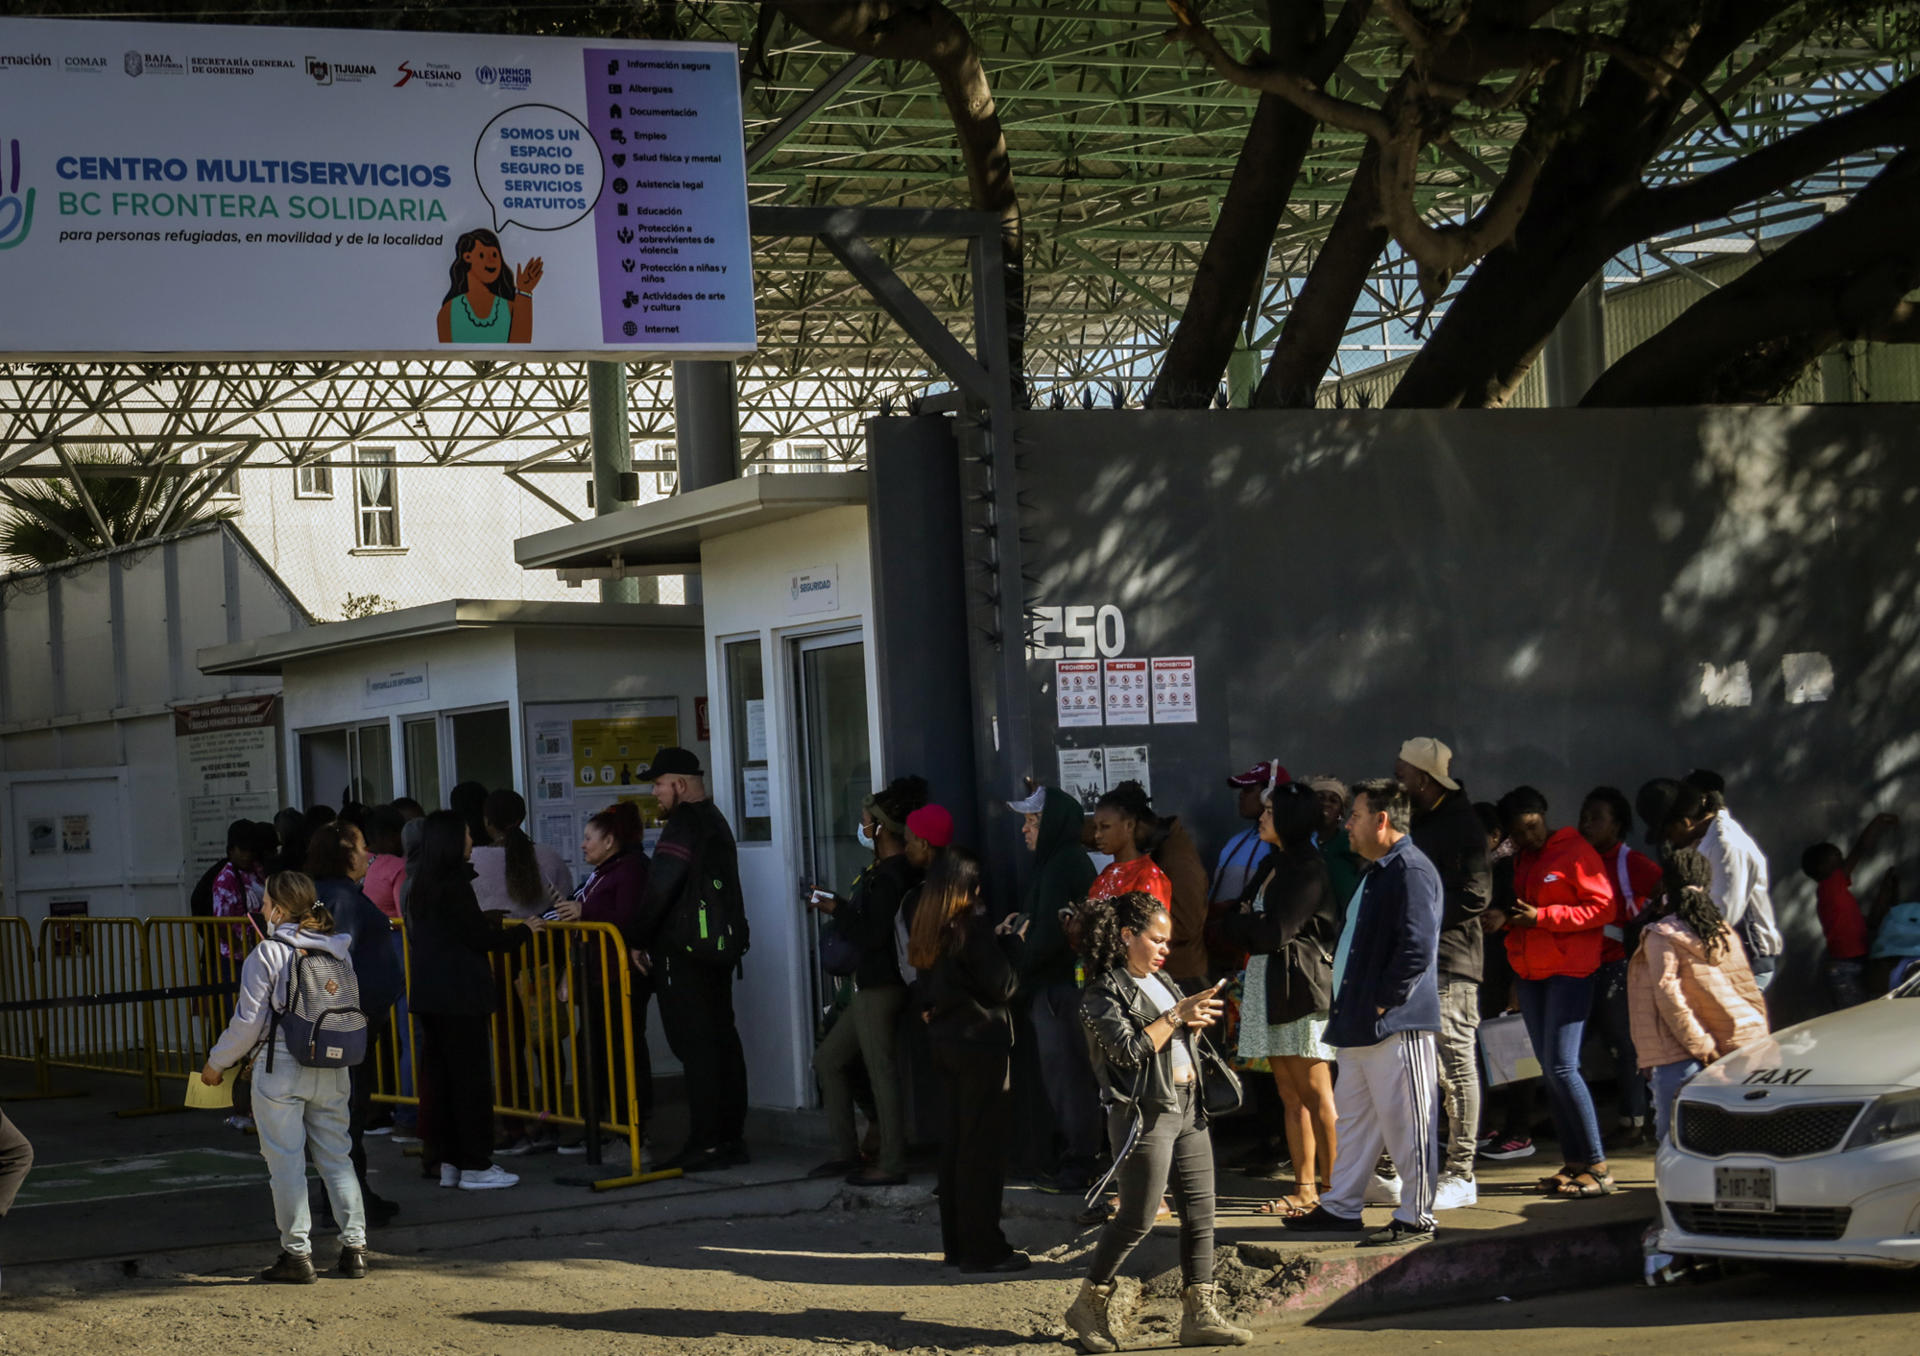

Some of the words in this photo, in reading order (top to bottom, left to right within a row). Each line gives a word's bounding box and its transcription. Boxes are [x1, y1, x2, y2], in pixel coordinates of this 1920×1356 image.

[65, 56, 108, 66] COMAR
[144, 54, 172, 63] BAJA
[191, 57, 250, 67] SECRETARÍA
[252, 59, 296, 68] GENERAL
[206, 66, 254, 75] GOBIERNO
[334, 63, 377, 74] TIJUANA
[627, 60, 680, 70] Información
[682, 62, 711, 71] segura
[498, 67, 532, 76] UNHCR
[499, 75, 532, 84] ACNUR
[629, 84, 673, 95] Albergues
[630, 107, 698, 117] Documentación
[500, 128, 555, 140] SOMOS
[558, 129, 580, 141] UN
[634, 131, 667, 141] Empleo
[510, 145, 572, 158] ESPACIO
[633, 153, 657, 161] Salud
[660, 153, 682, 162] física
[684, 155, 690, 163] y
[691, 155, 721, 163] mental
[56, 156, 188, 181] CENTRO
[196, 159, 451, 188] MULTISERVICIOS
[500, 162, 561, 175] SEGURO
[565, 164, 585, 175] DE
[504, 180, 583, 193] SERVICIOS
[636, 180, 680, 189] Asistencia
[682, 181, 704, 190] legal
[59, 192, 102, 216] BC
[112, 192, 279, 218] FRONTERA
[288, 195, 448, 222] SOLIDARIA
[503, 197, 587, 209] GRATUITOS
[637, 206, 682, 215] Educación
[638, 224, 684, 233] Protección
[59, 231, 92, 243] para
[96, 230, 161, 243] personas
[164, 229, 241, 245] refugiadas,
[246, 233, 262, 242] en
[267, 231, 332, 245] movilidad
[335, 235, 344, 247] y
[346, 232, 364, 245] de
[367, 232, 379, 245] la
[383, 233, 443, 246] localidad
[639, 236, 702, 244] sobrevivientes
[640, 246, 679, 254] violencia
[640, 263, 687, 272] Protección
[696, 263, 719, 272] niñas
[721, 265, 727, 273] y
[641, 274, 665, 283] niños
[642, 292, 693, 300] Actividades
[695, 292, 706, 300] de
[708, 292, 726, 300] arte
[643, 304, 648, 312] y
[650, 303, 681, 311] cultura
[645, 325, 680, 333] Internet
[1024, 605, 1125, 660] 250
[1060, 663, 1096, 671] PROHIBIDO
[1742, 1069, 1813, 1085] TAXI
